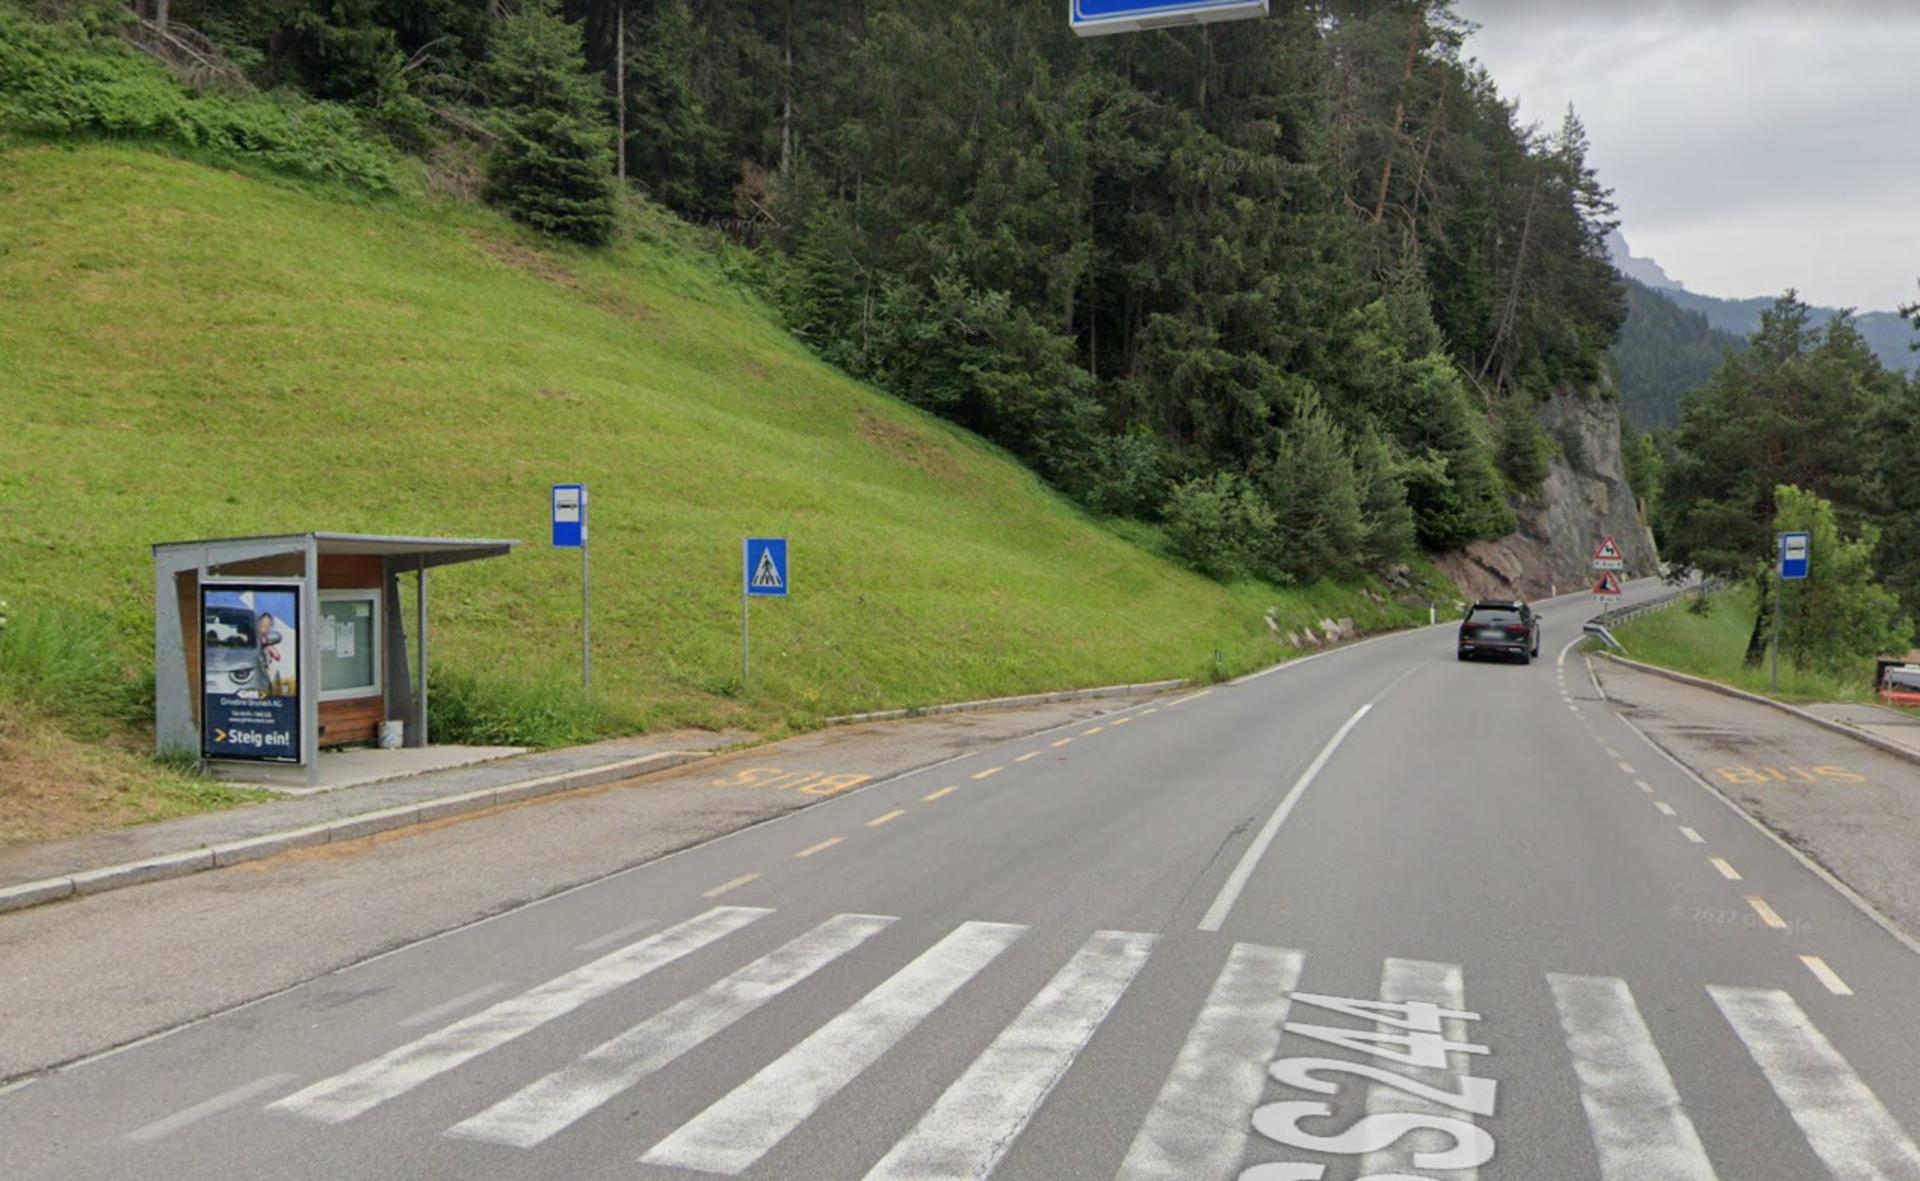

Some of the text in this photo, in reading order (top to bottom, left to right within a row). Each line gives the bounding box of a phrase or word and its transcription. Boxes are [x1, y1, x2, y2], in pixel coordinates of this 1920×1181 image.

[228, 729, 290, 748] Steig ein!
[711, 767, 873, 795] BUS
[1712, 766, 1867, 784] BUS
